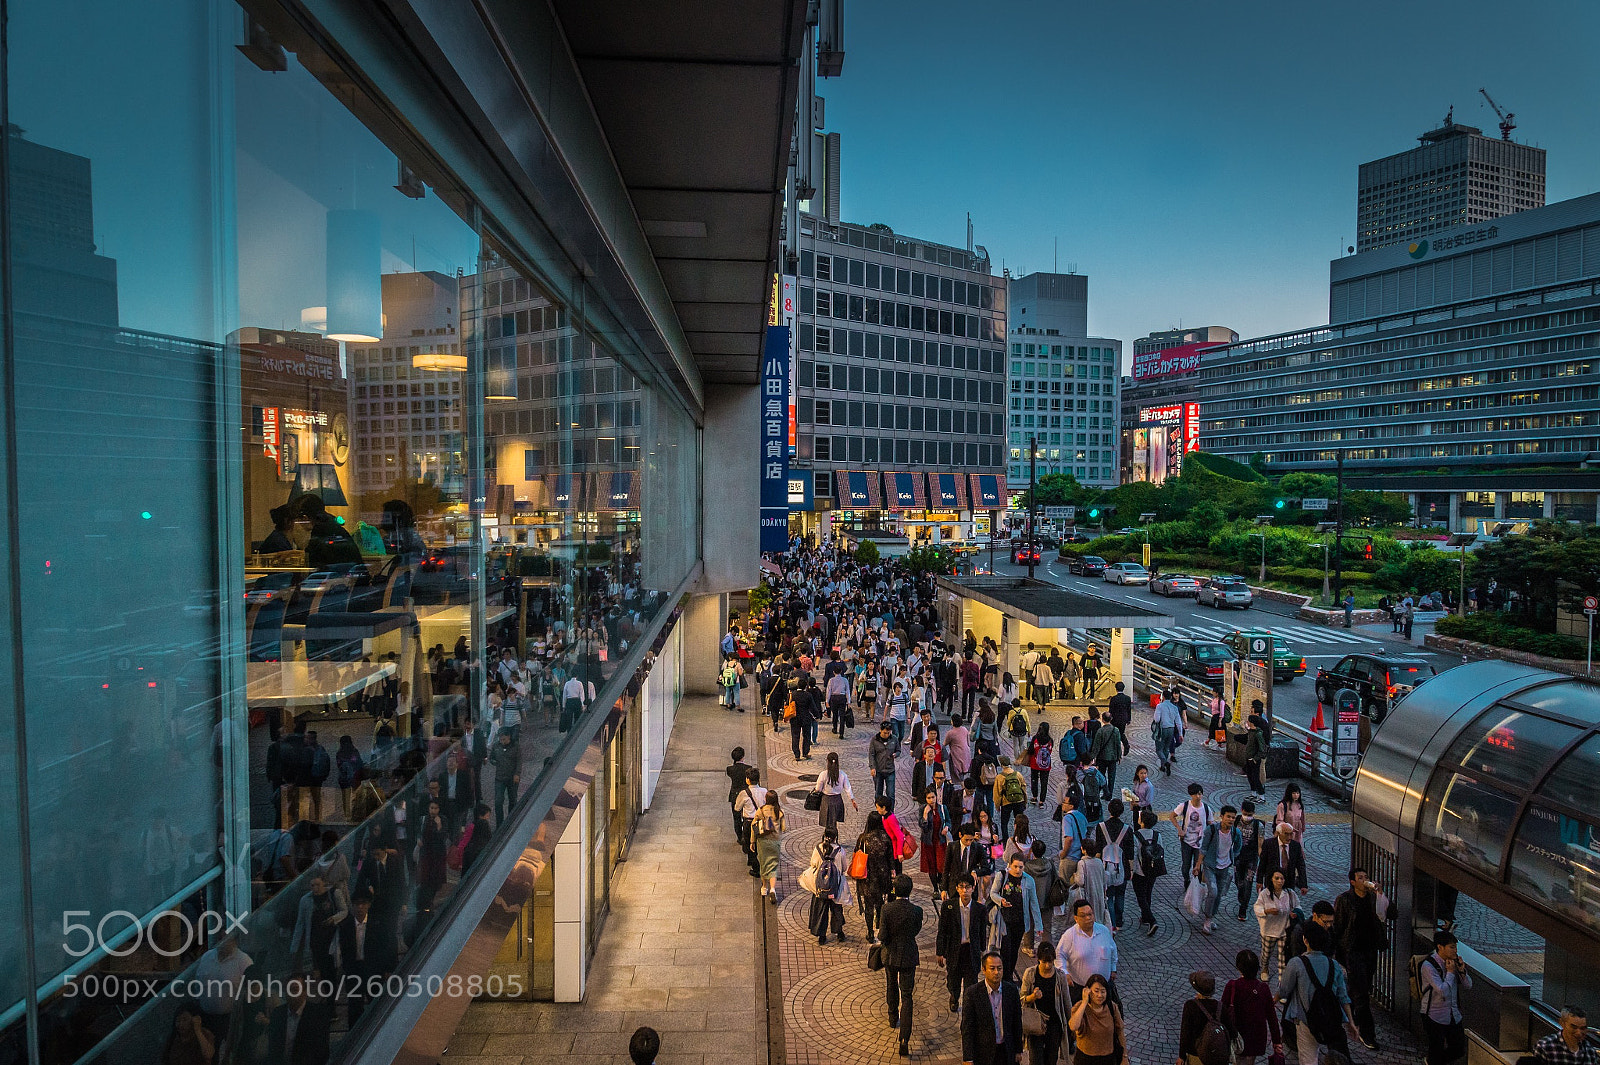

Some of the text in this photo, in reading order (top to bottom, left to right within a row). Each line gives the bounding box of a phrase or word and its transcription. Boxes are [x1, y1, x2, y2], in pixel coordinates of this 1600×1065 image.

[1433, 225, 1499, 252] 明治安田生命
[765, 357, 784, 480] 小田急百貨店
[851, 492, 867, 500] Keio
[898, 492, 912, 500] Keio
[941, 492, 955, 500] Keio
[761, 516, 787, 528] ODAKYU
